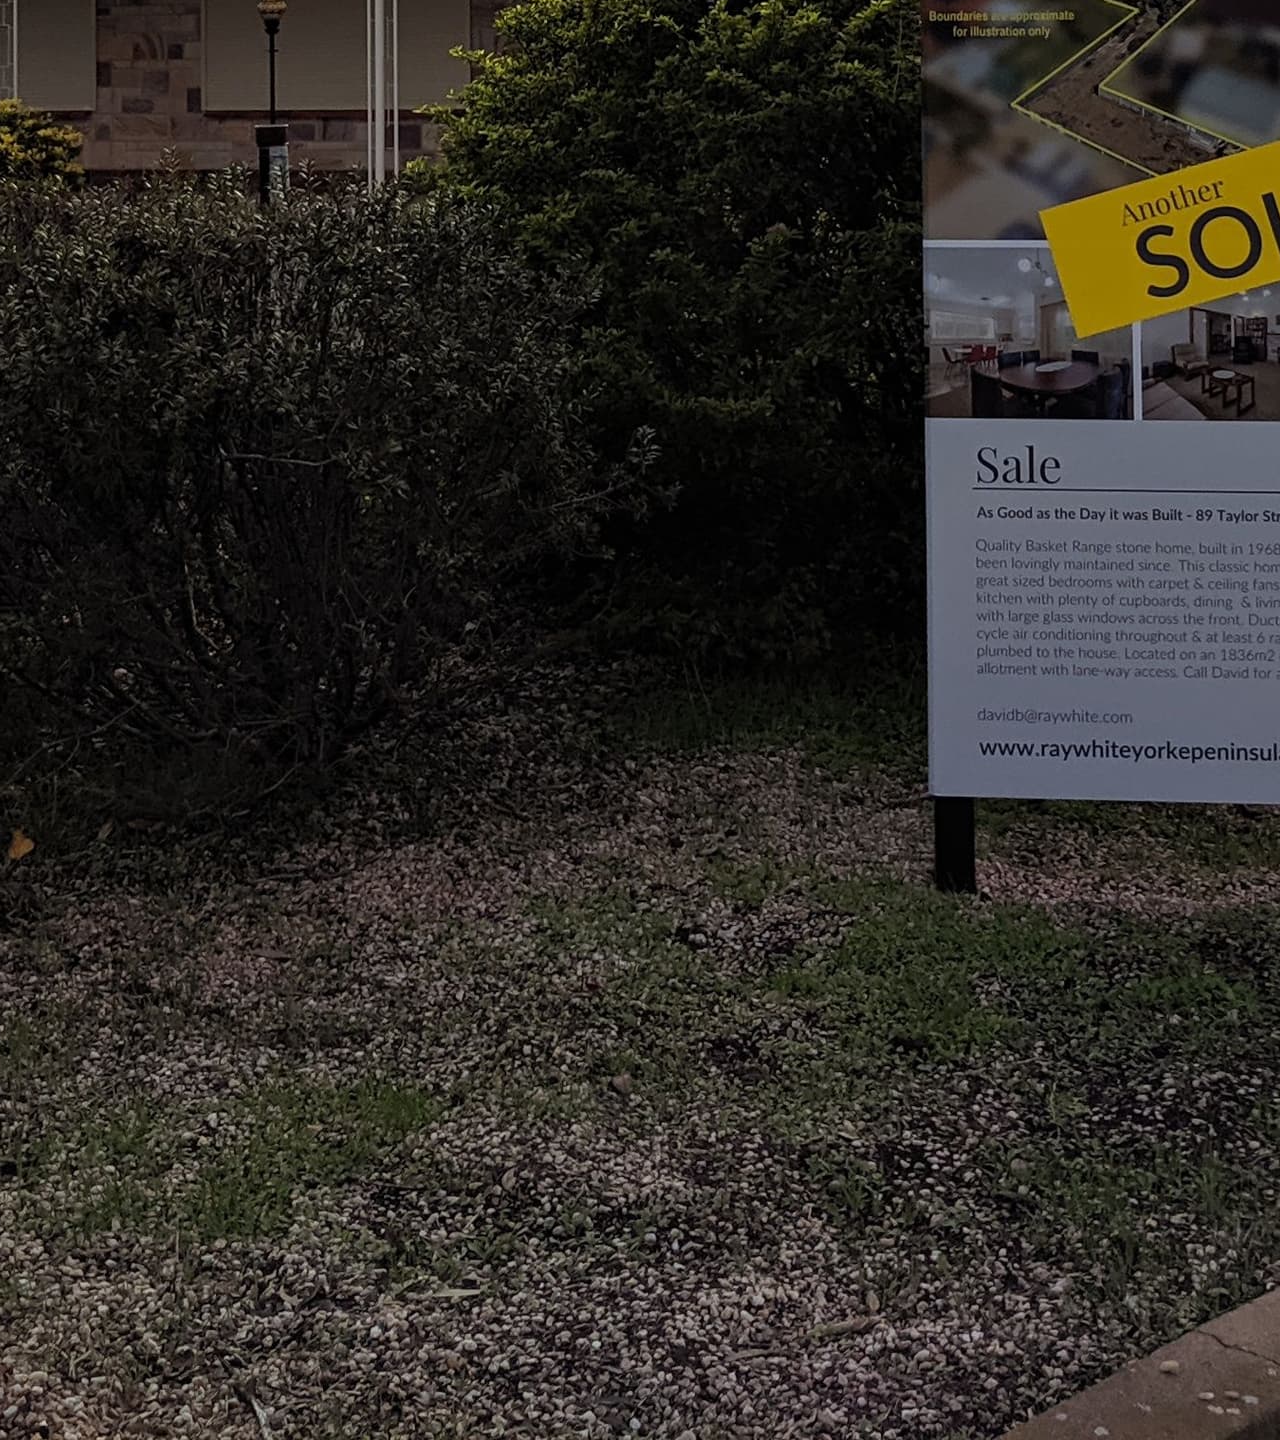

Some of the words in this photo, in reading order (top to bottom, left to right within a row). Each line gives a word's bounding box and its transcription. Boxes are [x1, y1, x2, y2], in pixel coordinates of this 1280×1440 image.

[928, 10, 988, 22] Boundaries
[953, 26, 968, 38] for
[1027, 26, 1051, 40] only
[1121, 179, 1225, 227] Another
[976, 444, 1062, 484] Sale
[976, 506, 994, 518] As
[996, 506, 1034, 519] Good
[1034, 510, 1051, 519] as
[1053, 507, 1077, 520] the
[1079, 508, 1107, 523] Day
[1109, 508, 1120, 520] it
[1121, 511, 1149, 521] was
[1151, 509, 1184, 521] Built
[1195, 509, 1214, 521] 89
[1215, 509, 1260, 526] Taylor
[975, 539, 1022, 555] Quality
[1025, 540, 1068, 553] Basket
[1072, 541, 1112, 557] Range
[1115, 541, 1152, 554] stone
[1198, 542, 1227, 555] built
[1231, 543, 1244, 555] in
[975, 557, 1008, 569] been
[1010, 557, 1061, 573] lovingly
[1063, 558, 1135, 571] maintained
[1177, 559, 1206, 572] This
[1208, 560, 1250, 572] classic
[976, 574, 1010, 590] great
[1011, 575, 1045, 587] sized
[1048, 575, 1113, 588] bedrooms
[1116, 576, 1145, 588] with
[1148, 576, 1190, 593] carpet
[1192, 577, 1204, 589] &
[1207, 577, 1250, 593] ceiling
[976, 592, 1023, 604] kitchen
[1026, 592, 1055, 605] with
[1058, 593, 1098, 609] plenty
[1101, 593, 1115, 606] of
[1193, 595, 1233, 611] dining
[1240, 595, 1251, 608] &
[975, 610, 1007, 622] with
[1007, 610, 1043, 626] large
[1042, 611, 1077, 627] glass
[1076, 611, 1137, 624] windows
[1137, 615, 1183, 625] across
[1182, 613, 1206, 625] the
[976, 627, 1011, 643] cycle
[1012, 628, 1032, 640] air
[1032, 628, 1112, 645] conditioning
[1114, 629, 1188, 646] throughout
[1191, 631, 1202, 643] &
[1205, 631, 1219, 643] at
[1221, 631, 1254, 644] least
[1255, 632, 1266, 644] 6
[976, 645, 1033, 661] plumbed
[1036, 646, 1051, 658] to
[1053, 646, 1075, 658] the
[1124, 647, 1176, 660] Located
[1179, 651, 1197, 661] on
[1199, 652, 1216, 661] an
[1221, 649, 1276, 662] 1836m2
[976, 663, 1038, 676] allotment
[1040, 664, 1070, 676] with
[1070, 664, 1132, 681] lane-way
[1182, 666, 1208, 678] Call
[1211, 667, 1250, 679] David
[1252, 667, 1273, 680] for
[977, 708, 1133, 724] davidb@raywhite.com
